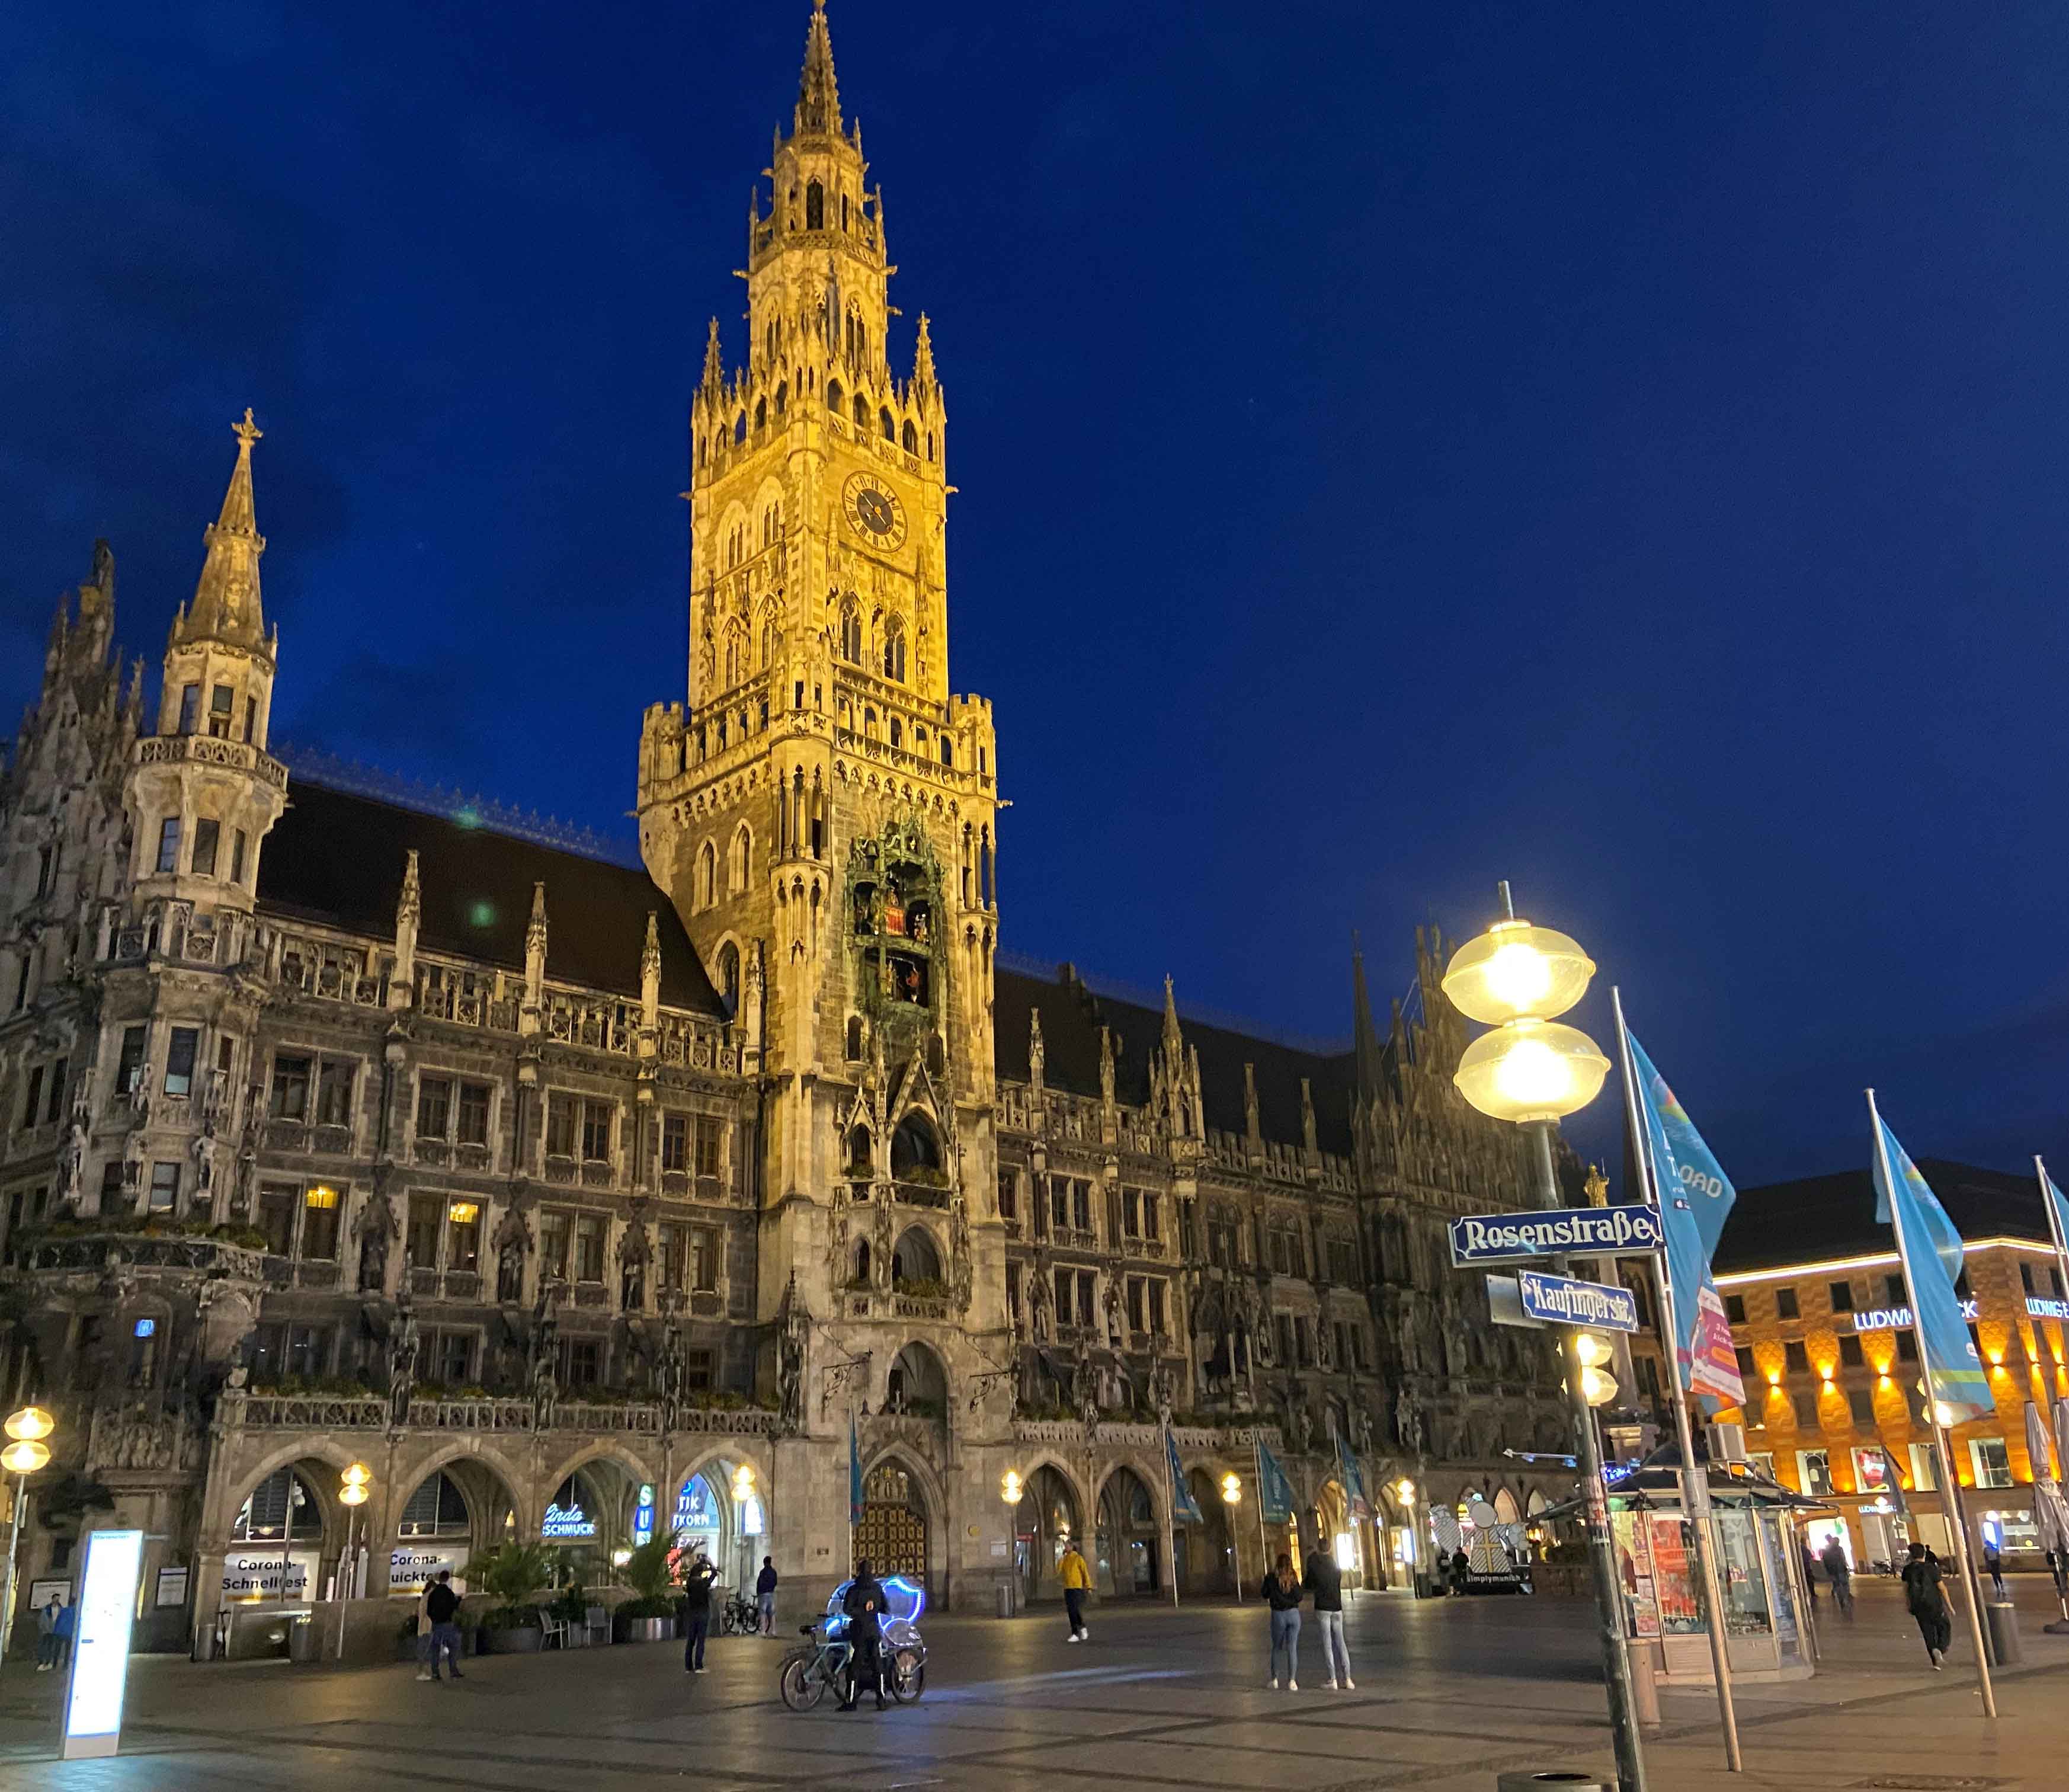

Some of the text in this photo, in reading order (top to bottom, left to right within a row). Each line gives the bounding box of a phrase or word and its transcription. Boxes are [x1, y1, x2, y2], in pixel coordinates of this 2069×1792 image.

[1465, 1211, 1651, 1250] Rosenstraße
[1853, 1308, 1912, 1330] LUDWI
[542, 1523, 595, 1537] SCHMUCK
[390, 1554, 441, 1565] Corona-
[222, 1576, 308, 1590] Schnellest
